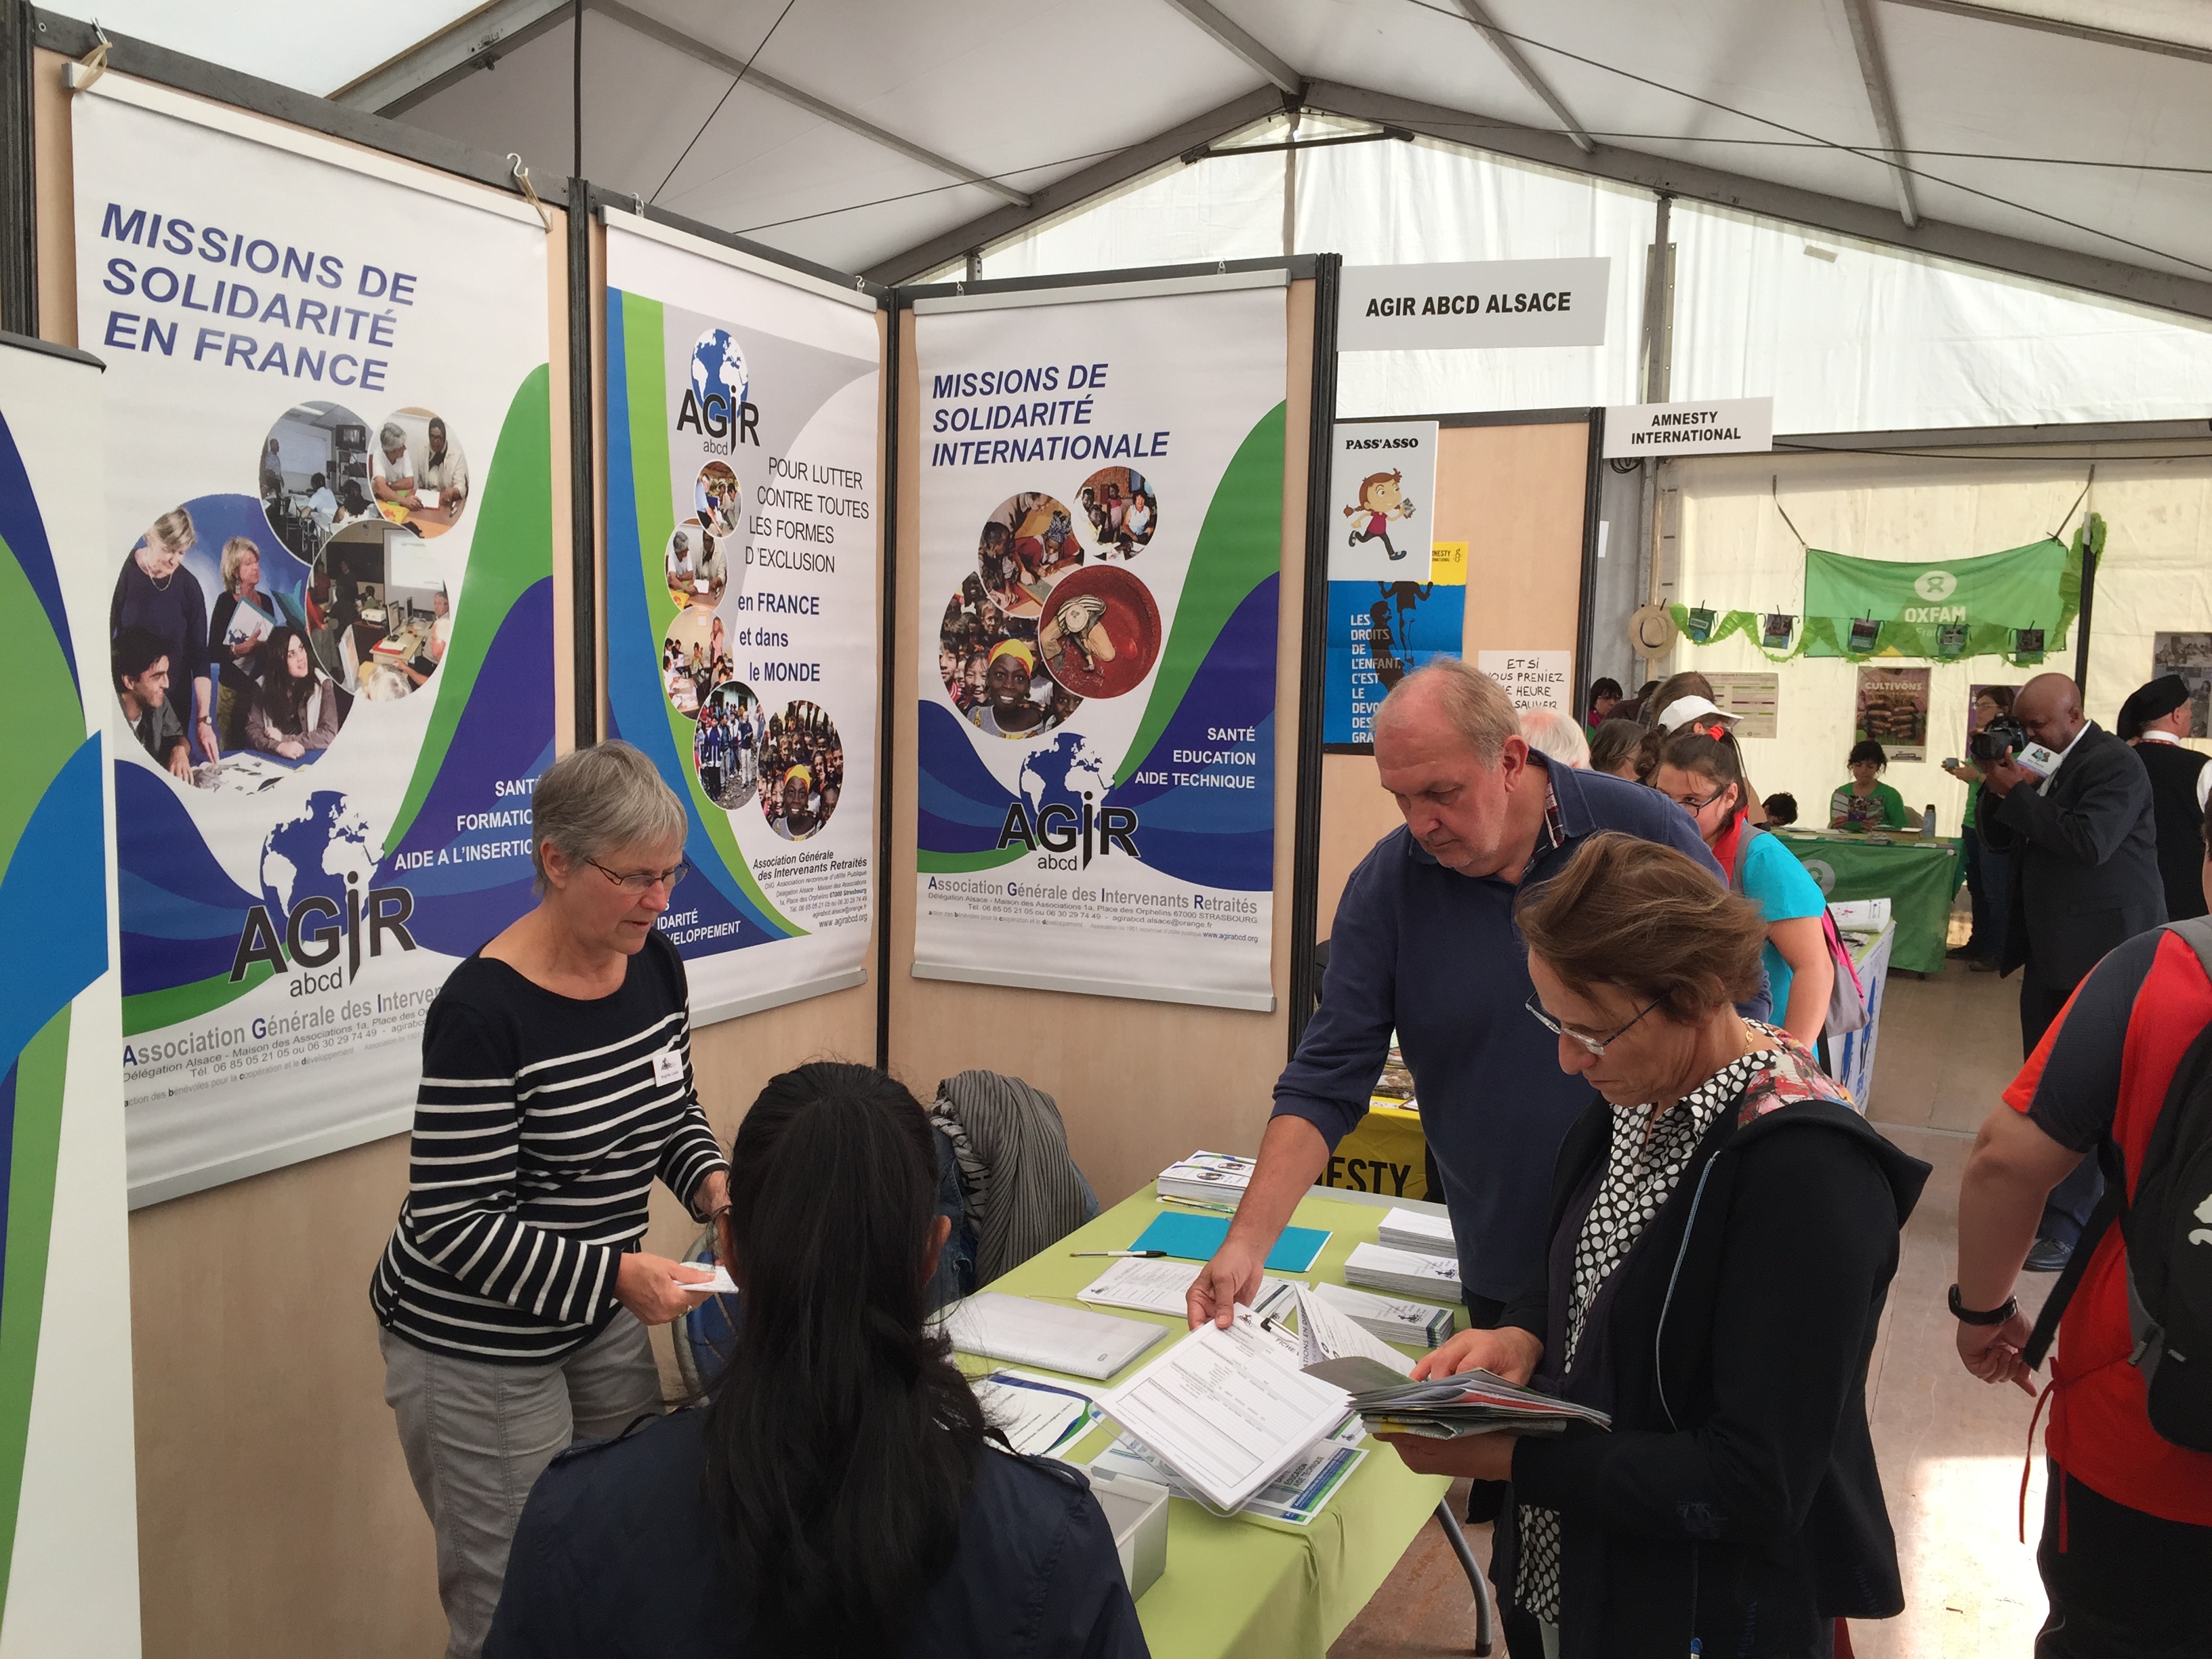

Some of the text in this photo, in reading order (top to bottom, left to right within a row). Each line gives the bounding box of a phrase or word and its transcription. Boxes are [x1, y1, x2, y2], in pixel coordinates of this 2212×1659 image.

[100, 203, 418, 306] MISSIONS DE
[102, 258, 397, 348] SOLIDARITÉ
[1366, 291, 1572, 316] AGIR ABCD ALSACE
[104, 310, 388, 392] EN FRANCE
[933, 363, 1109, 398] MISSIONS DE
[933, 394, 1094, 433] SOLIDARITÉ
[1652, 411, 1718, 426] AMNESTY
[1345, 437, 1419, 450] PASS'ASSO
[1631, 428, 1742, 445] INTERNATIONAL
[703, 439, 728, 455] abcd
[932, 431, 1170, 466] INTERNATIONALE
[769, 457, 863, 490] POUR LUTTER
[757, 486, 869, 519] CONTRE TOUTES
[750, 515, 834, 544] LES FORMES
[738, 592, 820, 615] en FRANCE
[1351, 614, 1370, 626] LES
[1904, 606, 1966, 623] OXFAM
[739, 627, 788, 647] et dans
[1351, 629, 1390, 640] DROITS
[1351, 644, 1366, 655] DE
[750, 662, 820, 681] le MONDE
[1352, 657, 1401, 670] L'ENFANT,
[1507, 659, 1525, 669] ET
[1352, 673, 1380, 684] C'EST
[1352, 688, 1365, 699] LE
[1517, 686, 1551, 697] HEURE
[1352, 703, 1380, 714] DEVO
[1352, 717, 1372, 729] DES
[1207, 726, 1256, 742] SANTÉ
[1352, 732, 1374, 743] GRA
[1173, 750, 1256, 765] EDUCATION
[495, 775, 541, 797] SANT
[1134, 771, 1256, 790] AIDE TECHNIQUE
[457, 809, 533, 832] FORMATIO
[394, 839, 533, 871] AIDE A L'INSERTIO
[753, 850, 834, 869] Association Générale
[1038, 854, 1078, 872] abcd
[758, 871, 772, 881] des
[774, 863, 827, 878] Intervenants
[830, 857, 867, 871] Retraités
[928, 876, 1257, 914] Association Générale des Intervenants Retraités
[657, 907, 698, 930] IDARITÉ
[965, 895, 988, 903] Alsace
[994, 898, 1019, 906] Maison
[1036, 901, 1082, 910] Associations
[1097, 905, 1118, 913] Place
[1136, 907, 1172, 917] Orphelins
[1173, 910, 1197, 918] 67000
[1199, 912, 1258, 924] STRASBOURG
[667, 920, 741, 945] VELOPPEMENT
[290, 966, 342, 998] abcd
[123, 1027, 245, 1067] Association
[252, 1006, 335, 1040] Générale
[341, 1000, 372, 1021] des
[123, 1063, 182, 1082] Délégation
[186, 1054, 222, 1068] Alsace
[232, 1044, 269, 1058] Maison
[272, 1040, 290, 1049] des
[293, 1025, 352, 1044] Associations
[373, 1017, 397, 1026] Place
[400, 1012, 415, 1021] des
[213, 1062, 226, 1073] 06
[230, 1055, 243, 1069] 85
[246, 1055, 259, 1065] 05
[262, 1052, 272, 1062] 21
[277, 1048, 289, 1058] 05
[293, 1046, 304, 1054] ou
[307, 1042, 320, 1051] 06
[323, 1038, 334, 1048] 30
[337, 1035, 349, 1044] 29
[352, 1032, 363, 1042] 74
[365, 1028, 377, 1038] 49
[151, 1090, 166, 1101] des
[1275, 1338, 1296, 1353] FICHE
